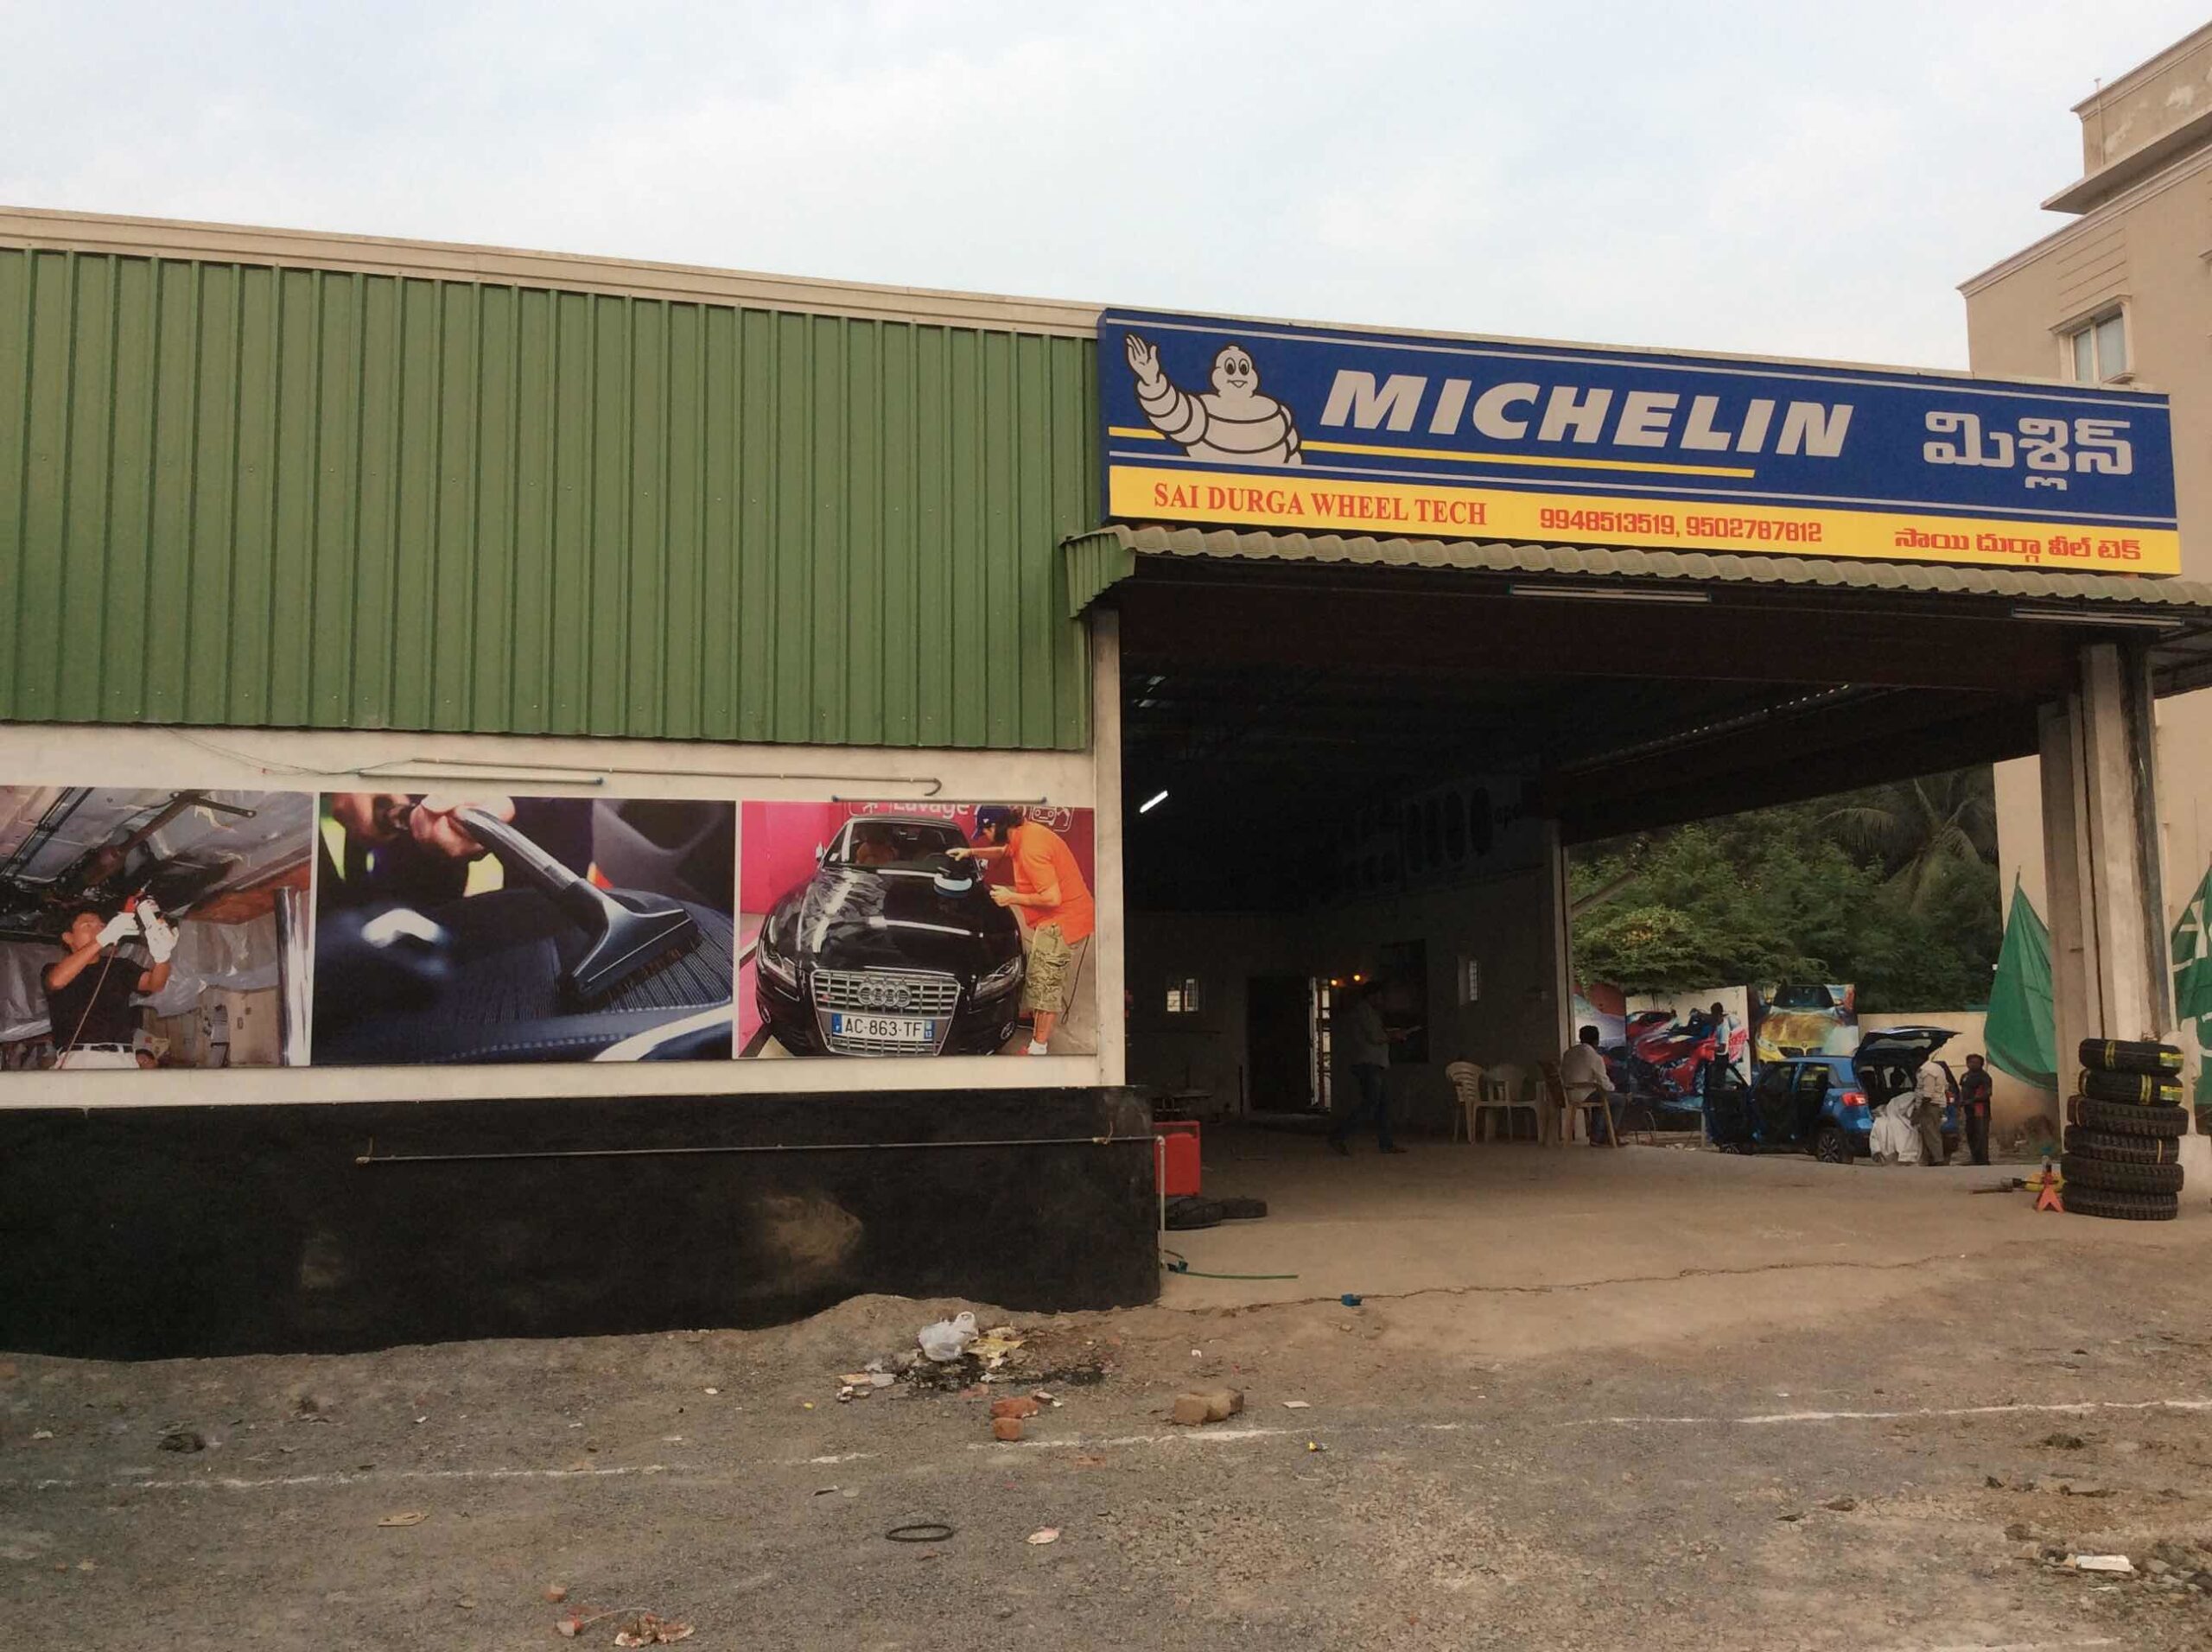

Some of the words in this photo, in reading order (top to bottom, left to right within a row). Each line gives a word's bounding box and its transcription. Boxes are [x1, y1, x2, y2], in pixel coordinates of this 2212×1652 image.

[1319, 369, 1854, 458] MICHELIN
[1154, 483, 1199, 508] SAI
[1209, 486, 1305, 515] DURGA
[1311, 492, 1408, 520] WHEEL
[1414, 499, 1487, 525] TECH
[1686, 516, 1822, 542] 9502787812
[1895, 528, 1969, 550] సాయి
[1977, 533, 2041, 562] దుర్గా
[2049, 536, 2091, 557] వీల్
[2098, 539, 2141, 560] టెక్
[845, 1018, 923, 1037] AC-863-TF
